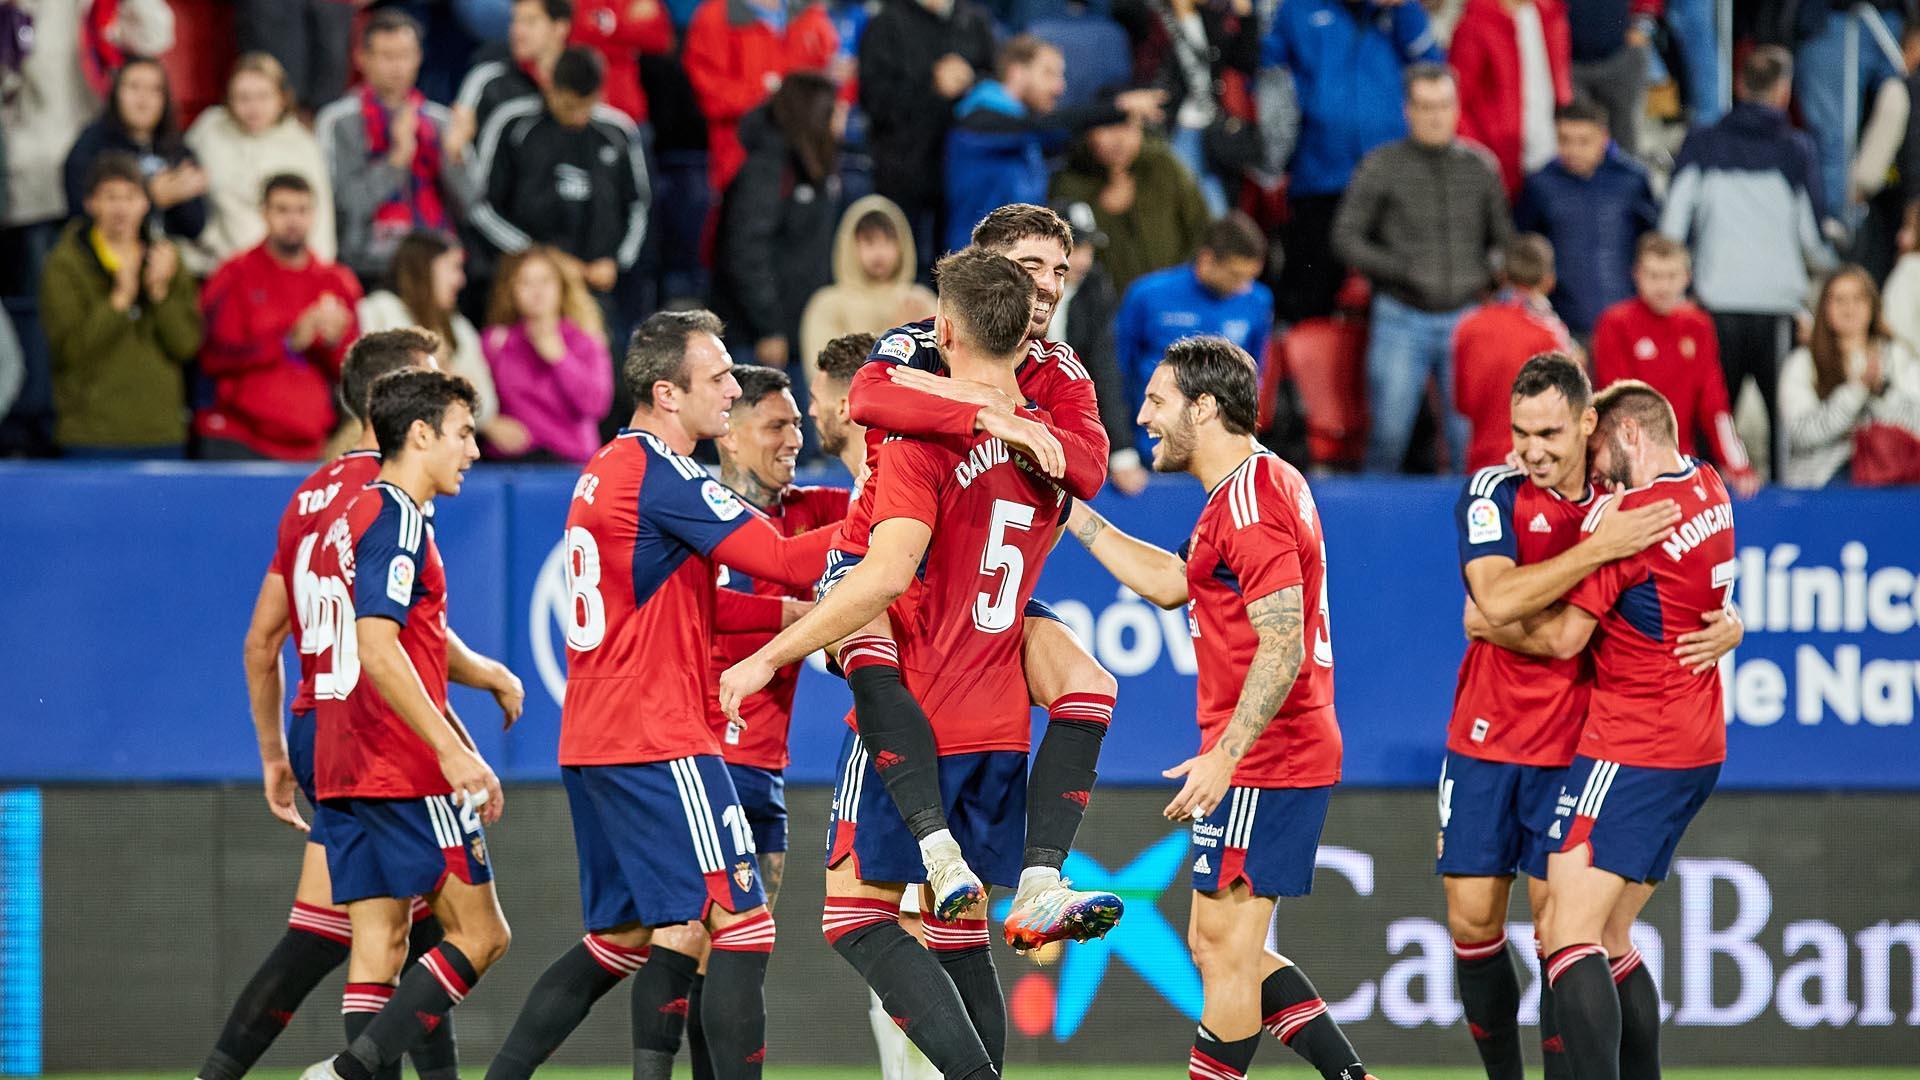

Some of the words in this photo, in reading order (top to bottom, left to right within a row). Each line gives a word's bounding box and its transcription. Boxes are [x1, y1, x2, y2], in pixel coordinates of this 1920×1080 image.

[955, 437, 1010, 489] DAVID
[564, 525, 607, 652] 8
[971, 499, 1037, 634] 5
[1711, 558, 1736, 615] 7
[1734, 541, 1920, 634] línic
[1796, 643, 1920, 727] Na
